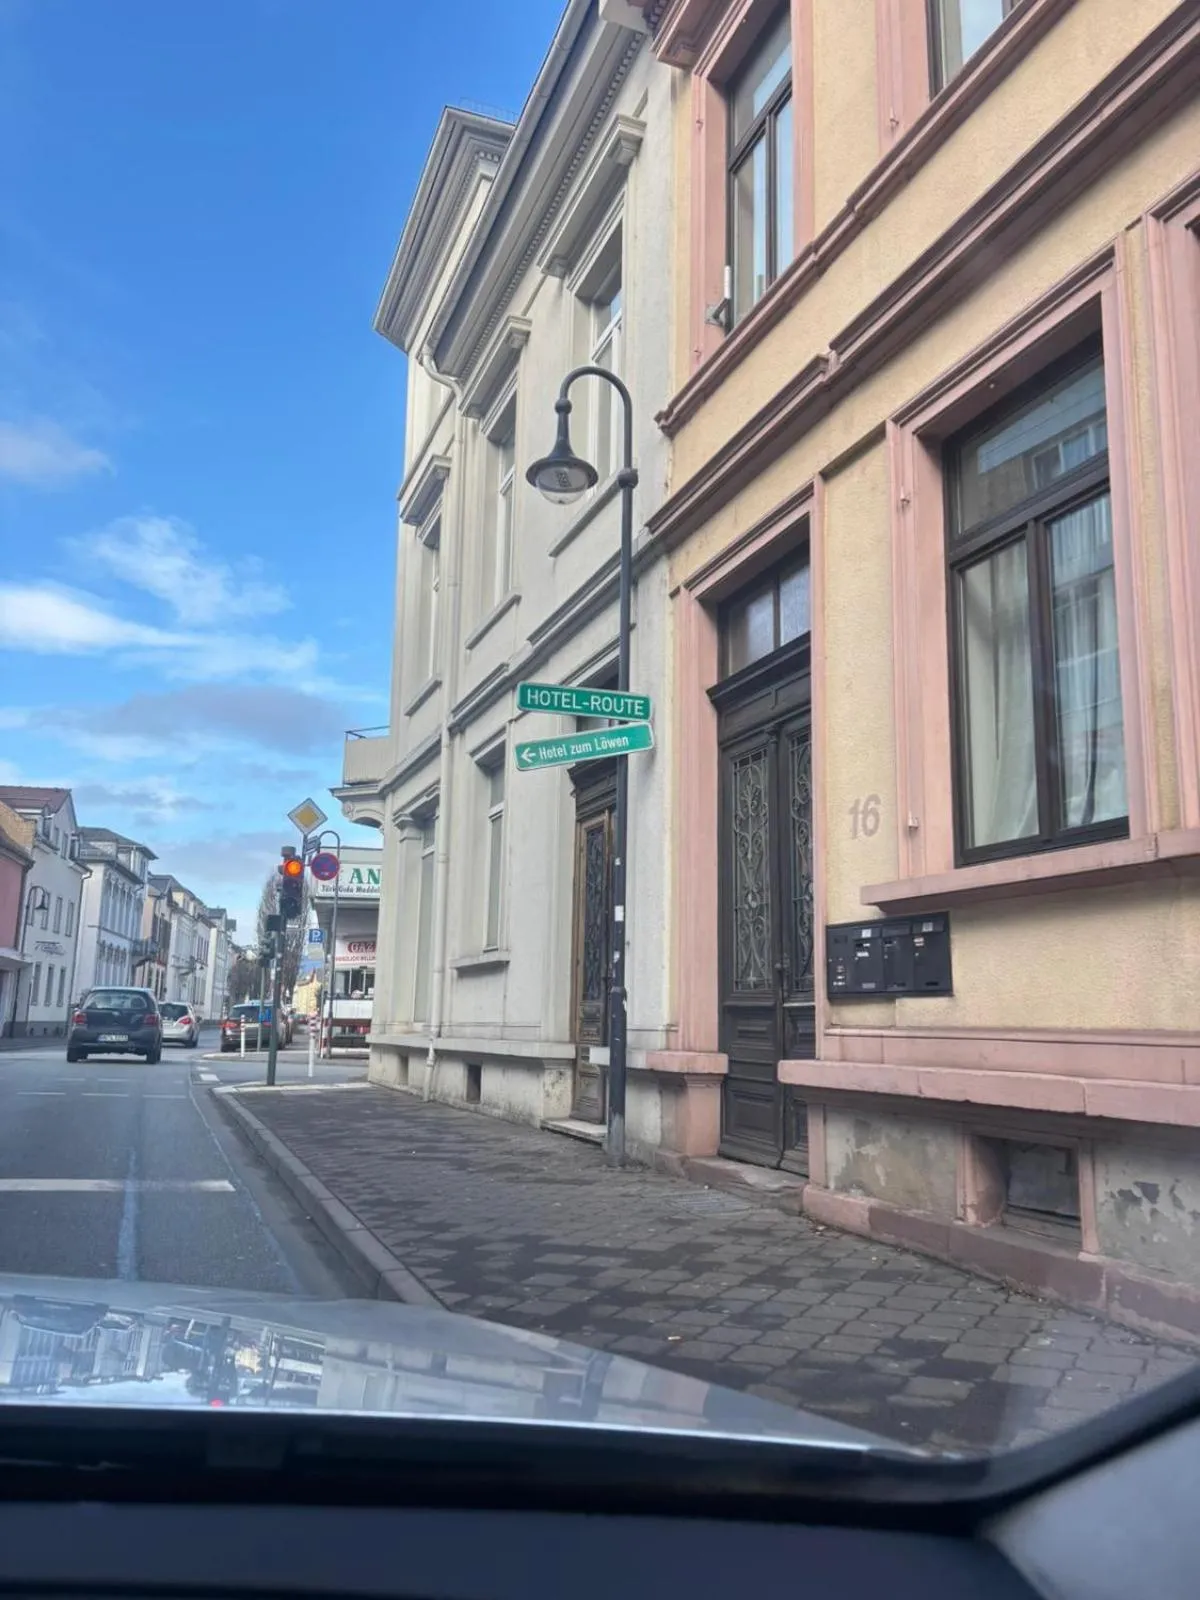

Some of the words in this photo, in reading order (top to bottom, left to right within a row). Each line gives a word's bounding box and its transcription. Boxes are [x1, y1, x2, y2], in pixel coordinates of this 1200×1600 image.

[527, 688, 645, 716] HOTEL-ROUTE
[539, 745, 568, 760] Hotel
[570, 742, 592, 755] zum
[594, 736, 630, 752] Löwen
[848, 793, 882, 840] 16
